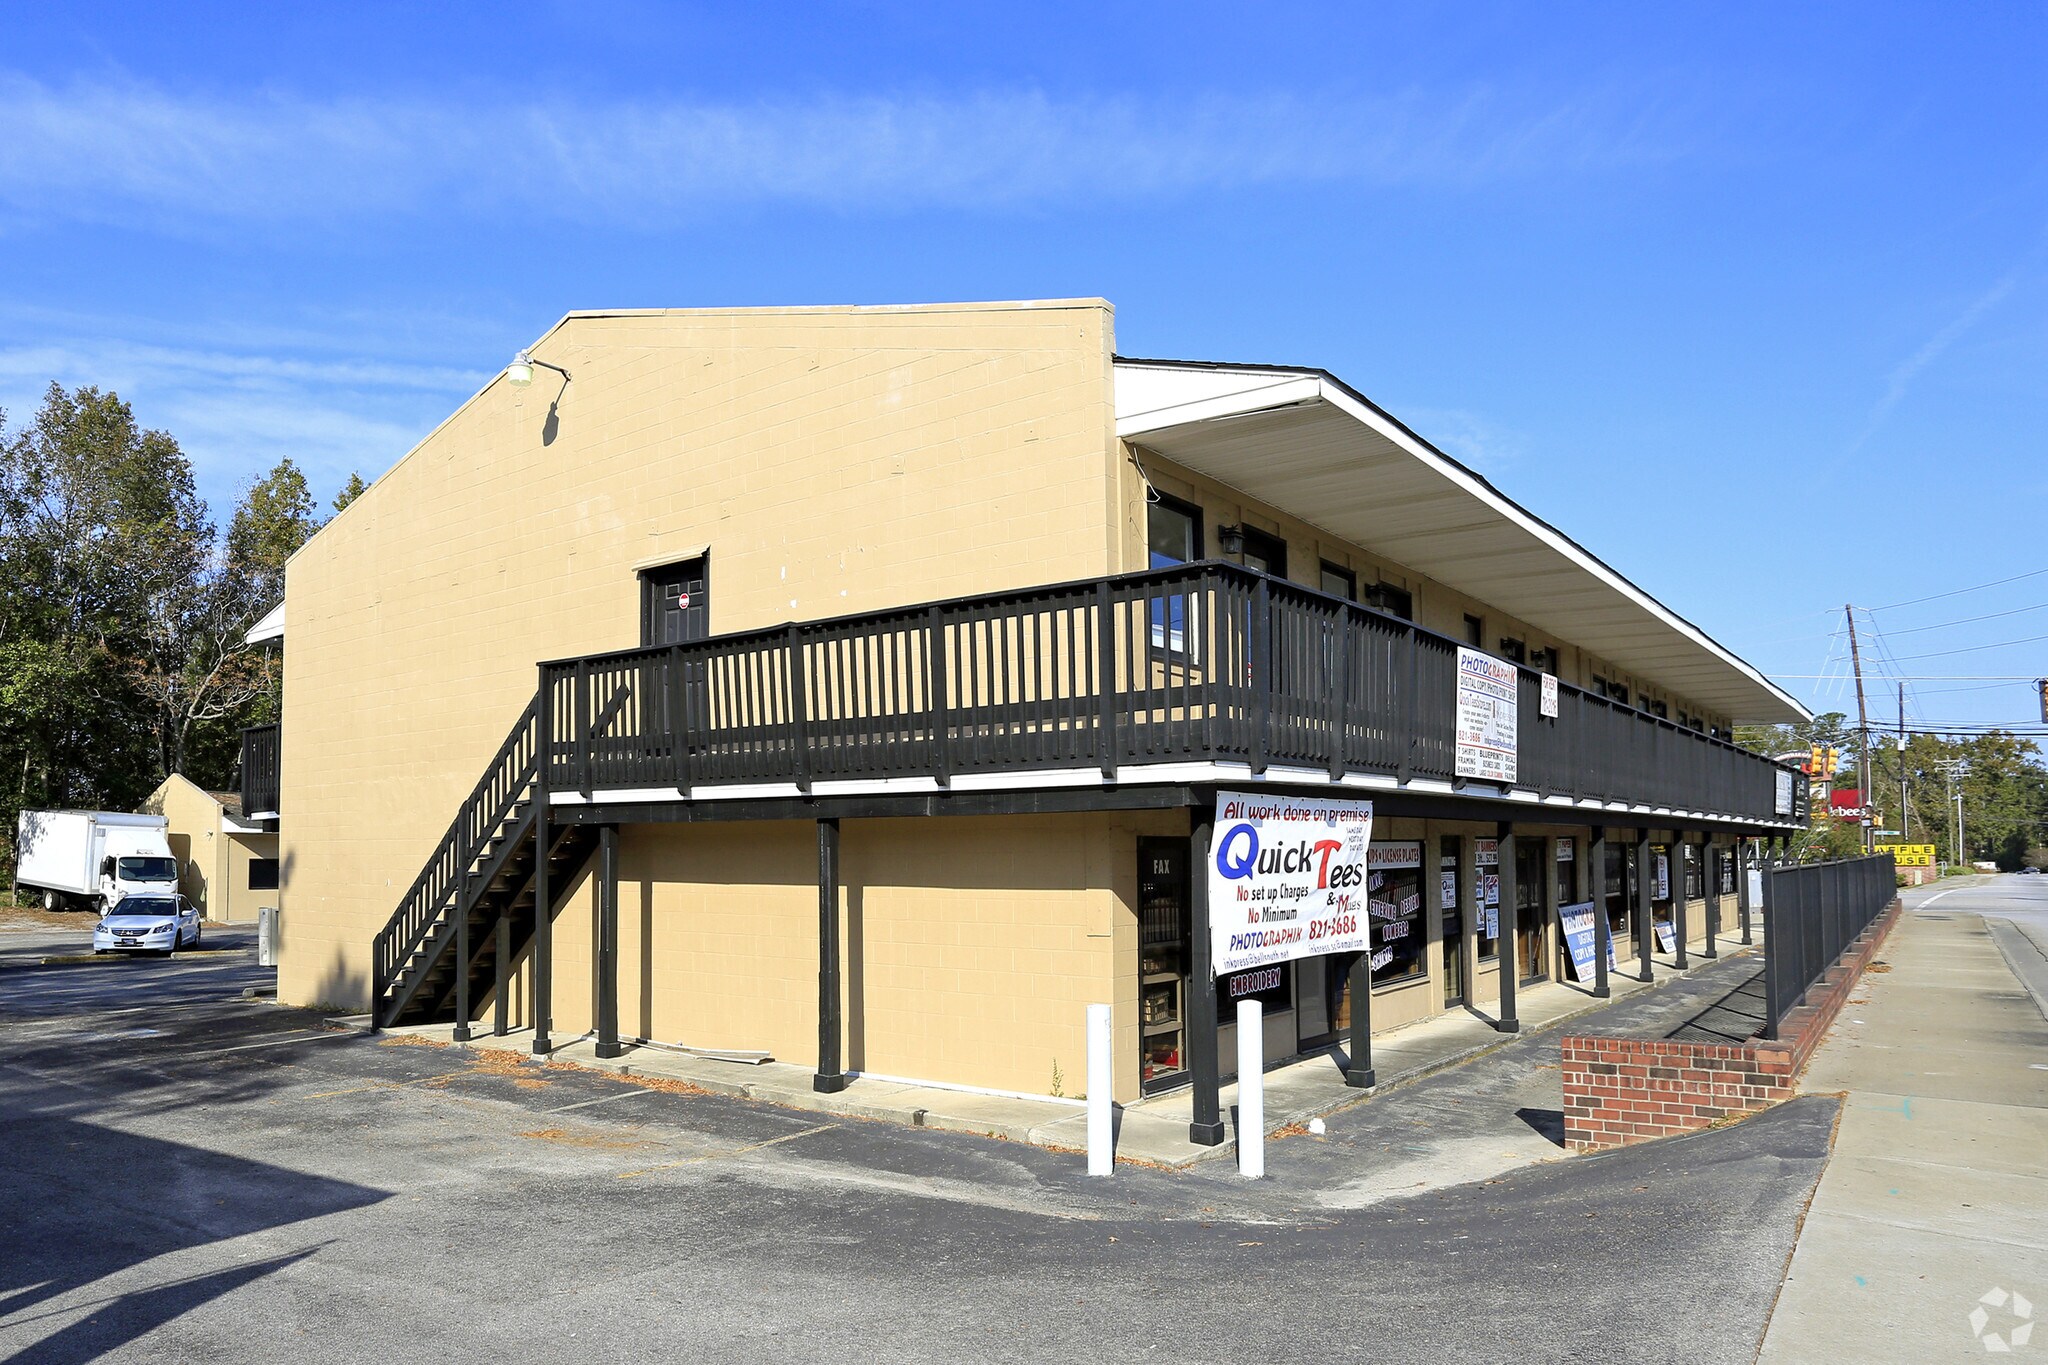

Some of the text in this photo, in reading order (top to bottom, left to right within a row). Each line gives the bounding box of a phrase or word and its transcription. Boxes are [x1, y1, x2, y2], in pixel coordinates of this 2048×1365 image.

[1461, 654, 1516, 684] PHOTOGRAPHIK
[1458, 756, 1476, 766] FRAMING
[1480, 750, 1504, 761] BLUEPRINTS
[1458, 766, 1476, 775] BANNERS
[1224, 801, 1370, 822] All work done on premise
[1402, 847, 1420, 862] PLATES
[1864, 846, 1932, 854] AFFLE
[1153, 859, 1170, 874] FAX
[1237, 883, 1309, 904] No set up Charges
[1327, 892, 1336, 906] &
[1248, 906, 1298, 924] No Minimum
[1230, 915, 1357, 951] PHOTOGRAPHIK 821-3686
[1230, 967, 1281, 997] EMBROIDERY
